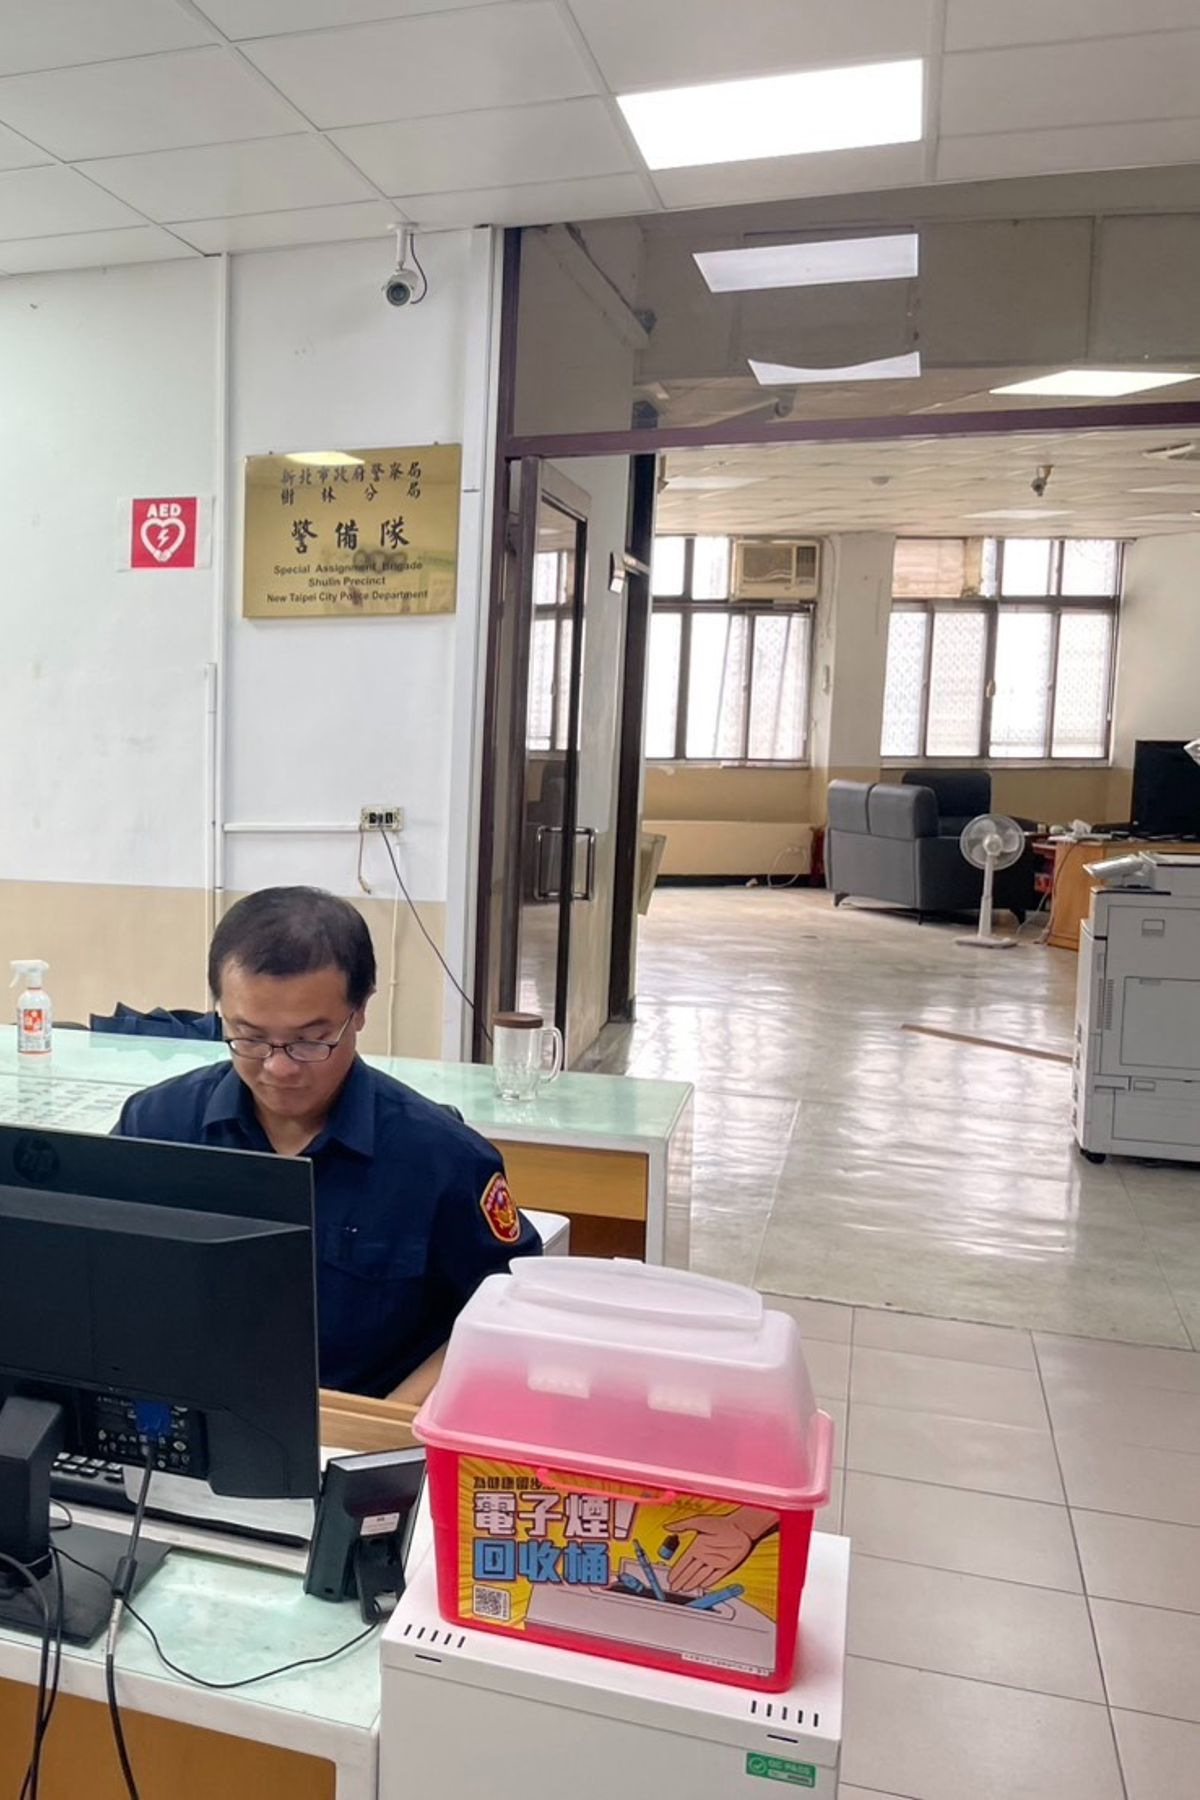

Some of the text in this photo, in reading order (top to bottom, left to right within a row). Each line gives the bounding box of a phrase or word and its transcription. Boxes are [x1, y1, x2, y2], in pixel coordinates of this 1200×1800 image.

[280, 461, 422, 486] 新北市政府警察局
[281, 481, 421, 506] 樹林分局
[146, 502, 182, 518] AED
[291, 515, 410, 555] 警備隊
[273, 560, 423, 577] Special Assignment Brigade
[308, 575, 386, 588] Shulin Precinct
[267, 593, 287, 603] New
[289, 591, 317, 603] Taipei
[318, 591, 338, 603] City
[371, 587, 428, 600] Department
[473, 1491, 638, 1541] 電子煙!
[473, 1536, 609, 1586] 回收桶
